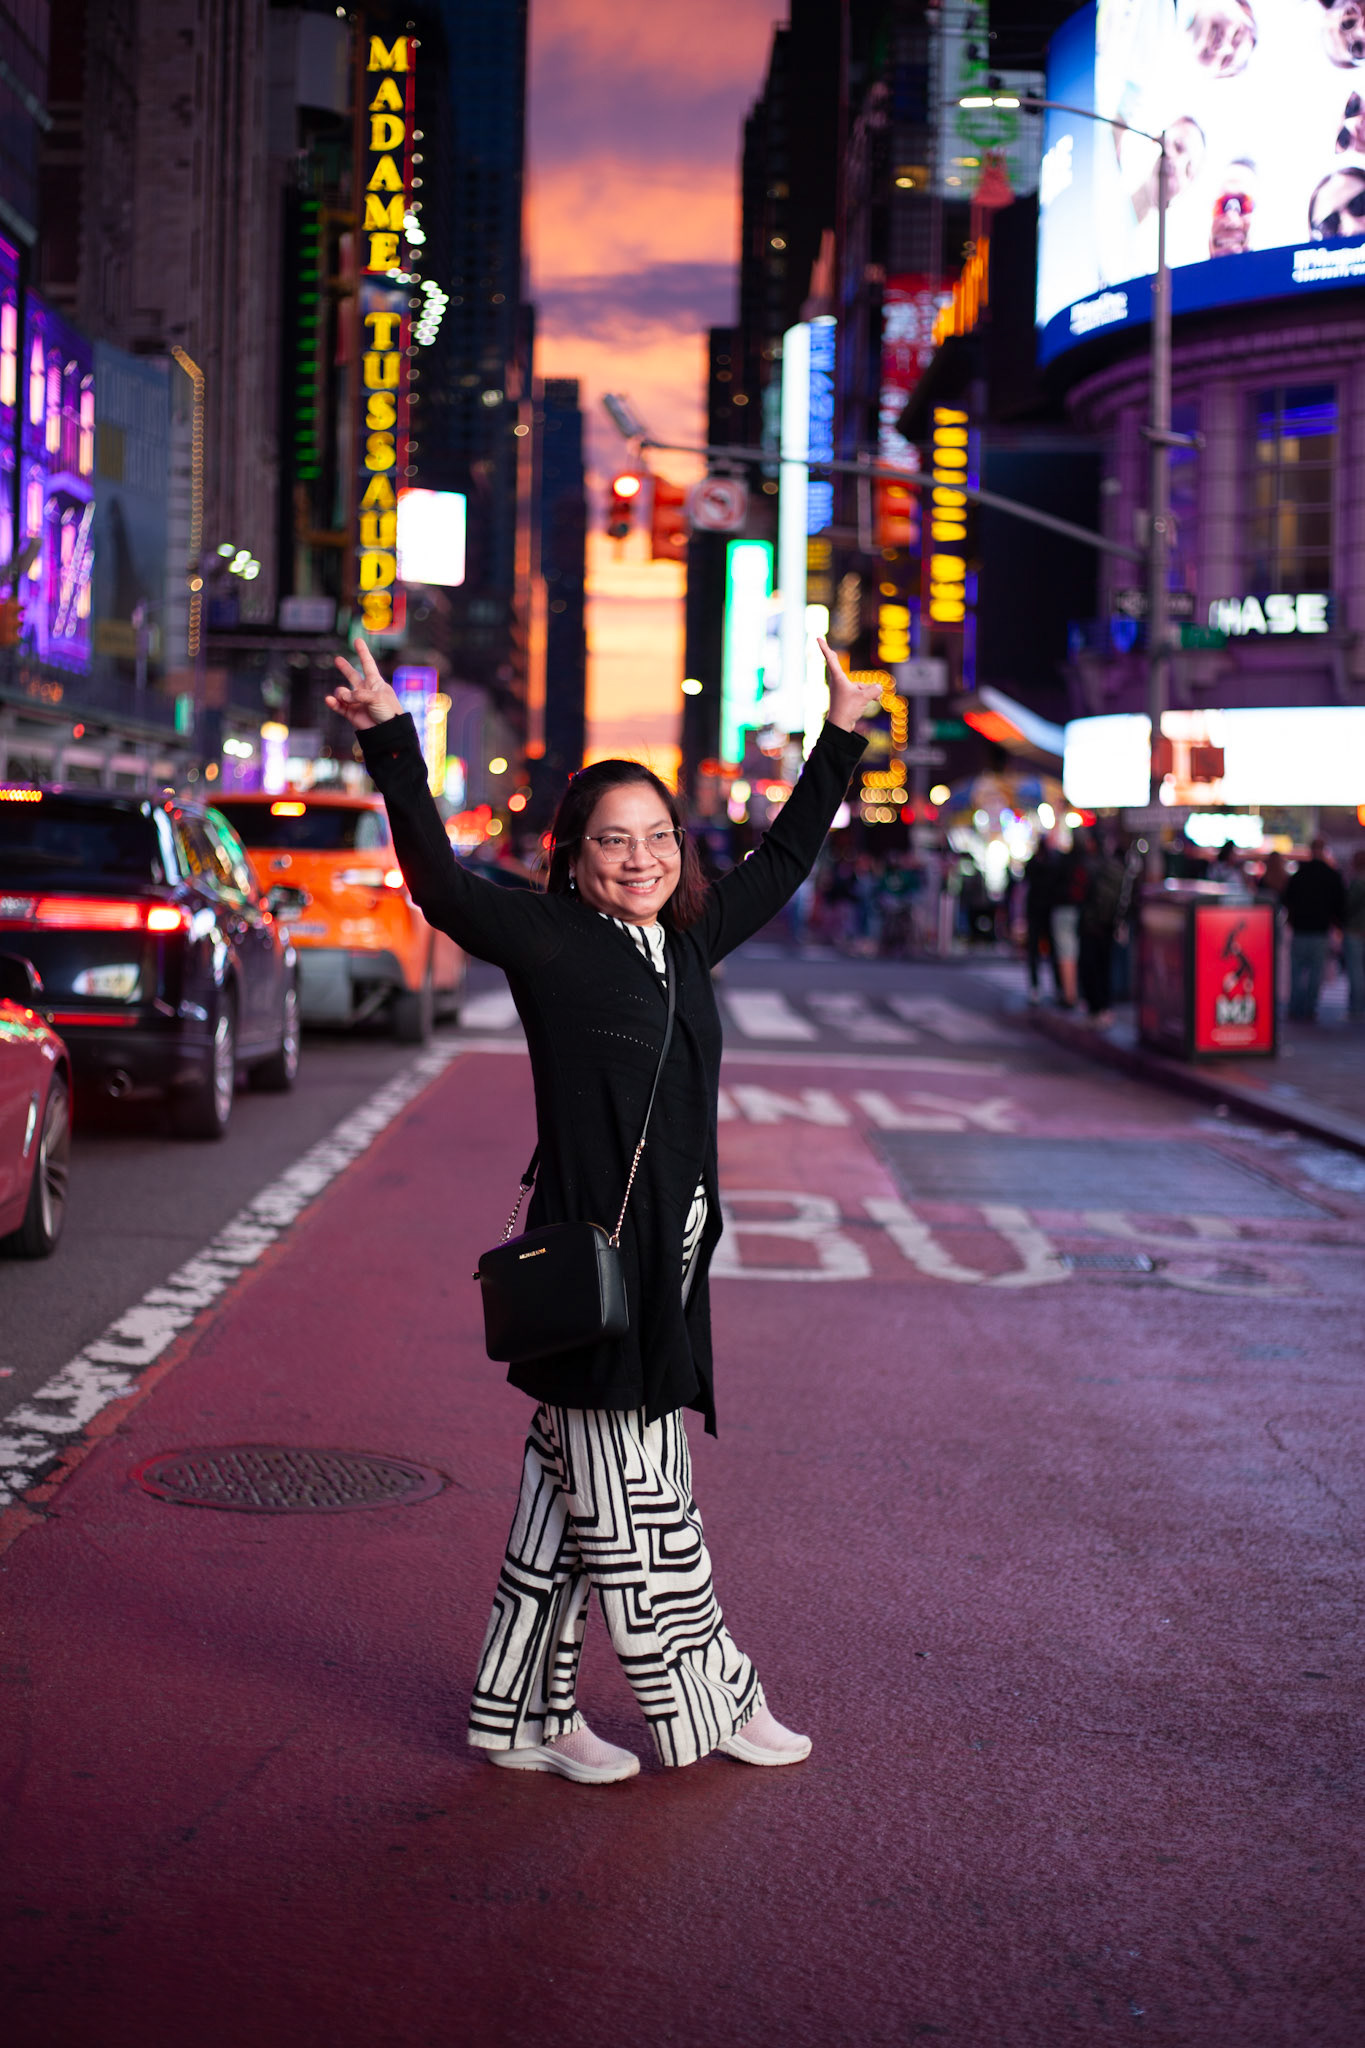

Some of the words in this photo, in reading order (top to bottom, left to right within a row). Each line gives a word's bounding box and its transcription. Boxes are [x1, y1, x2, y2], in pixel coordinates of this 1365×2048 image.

[362, 35, 410, 271] MADAME
[360, 312, 401, 631] TUSSAUDS
[718, 1084, 1017, 1132] NLY
